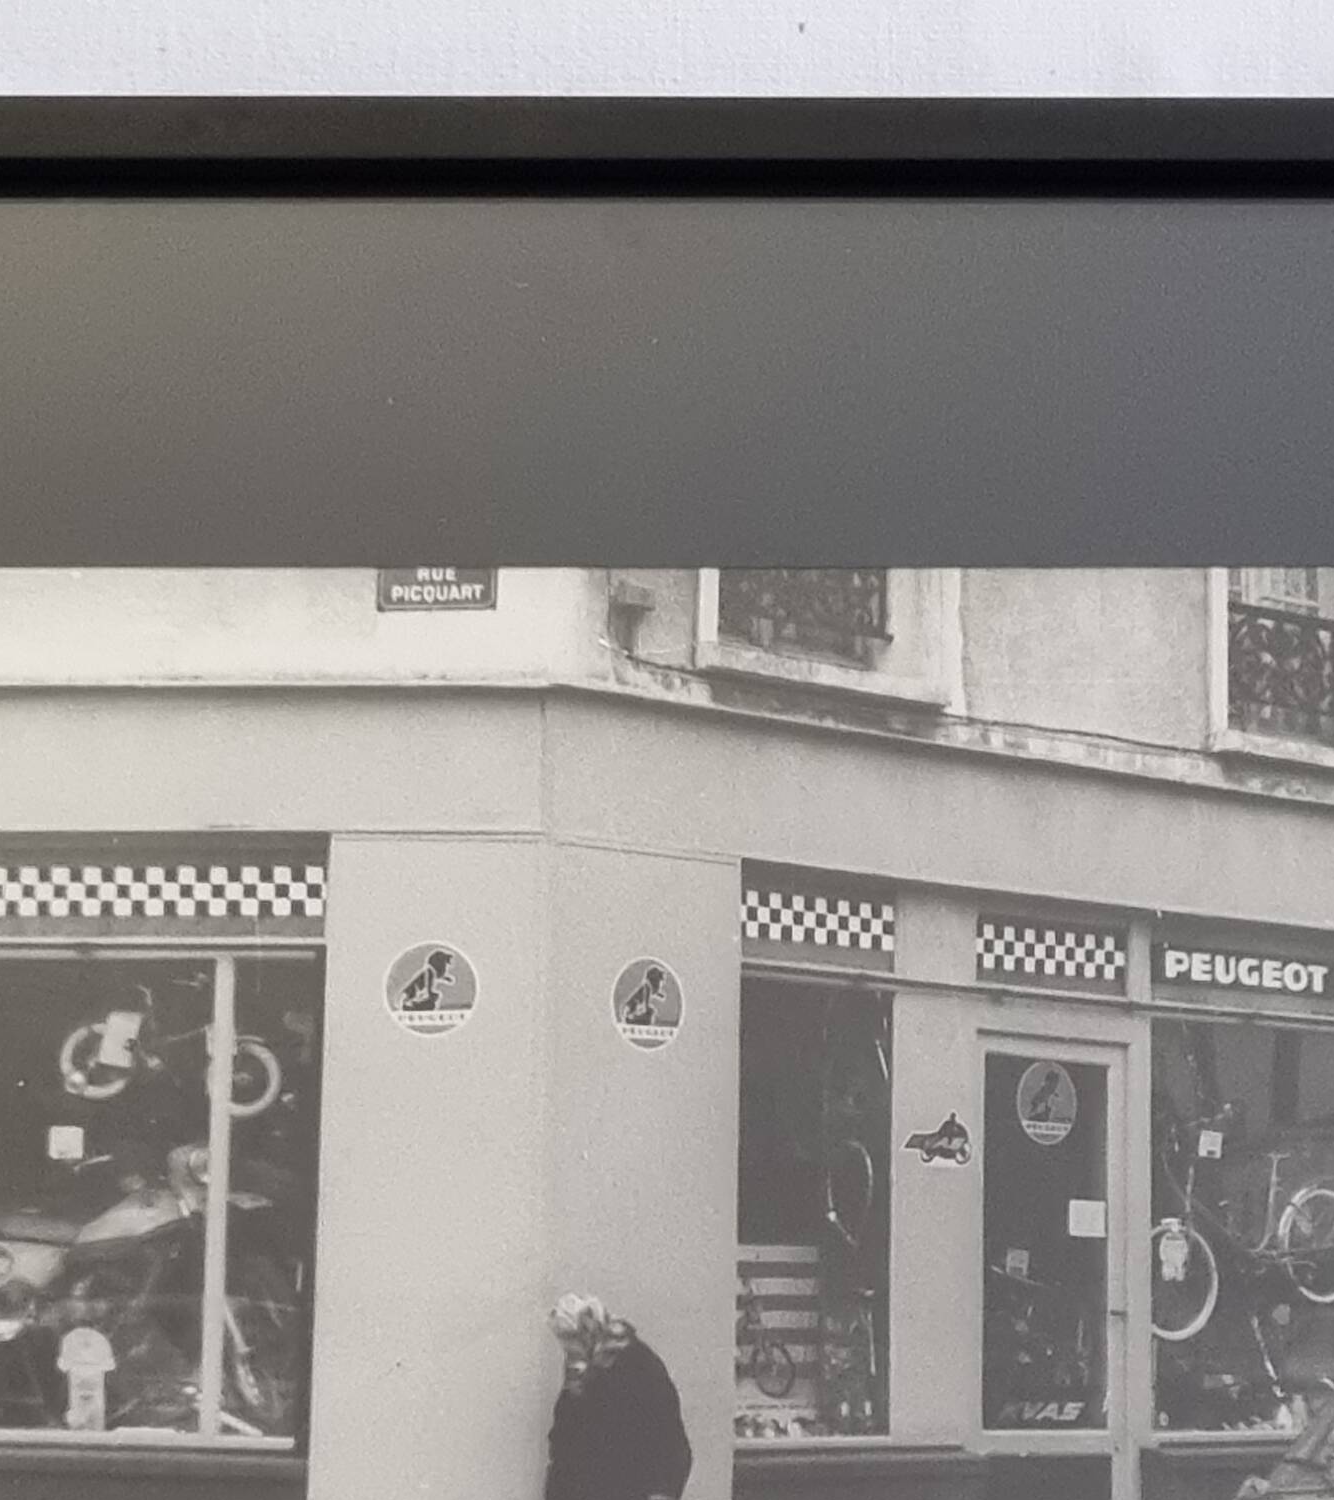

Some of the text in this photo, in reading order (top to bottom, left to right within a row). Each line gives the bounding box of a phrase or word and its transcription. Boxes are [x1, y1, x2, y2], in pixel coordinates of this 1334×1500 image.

[416, 566, 457, 581] RUE
[390, 583, 485, 604] PICQUART
[1165, 950, 1328, 993] PEUGEOT
